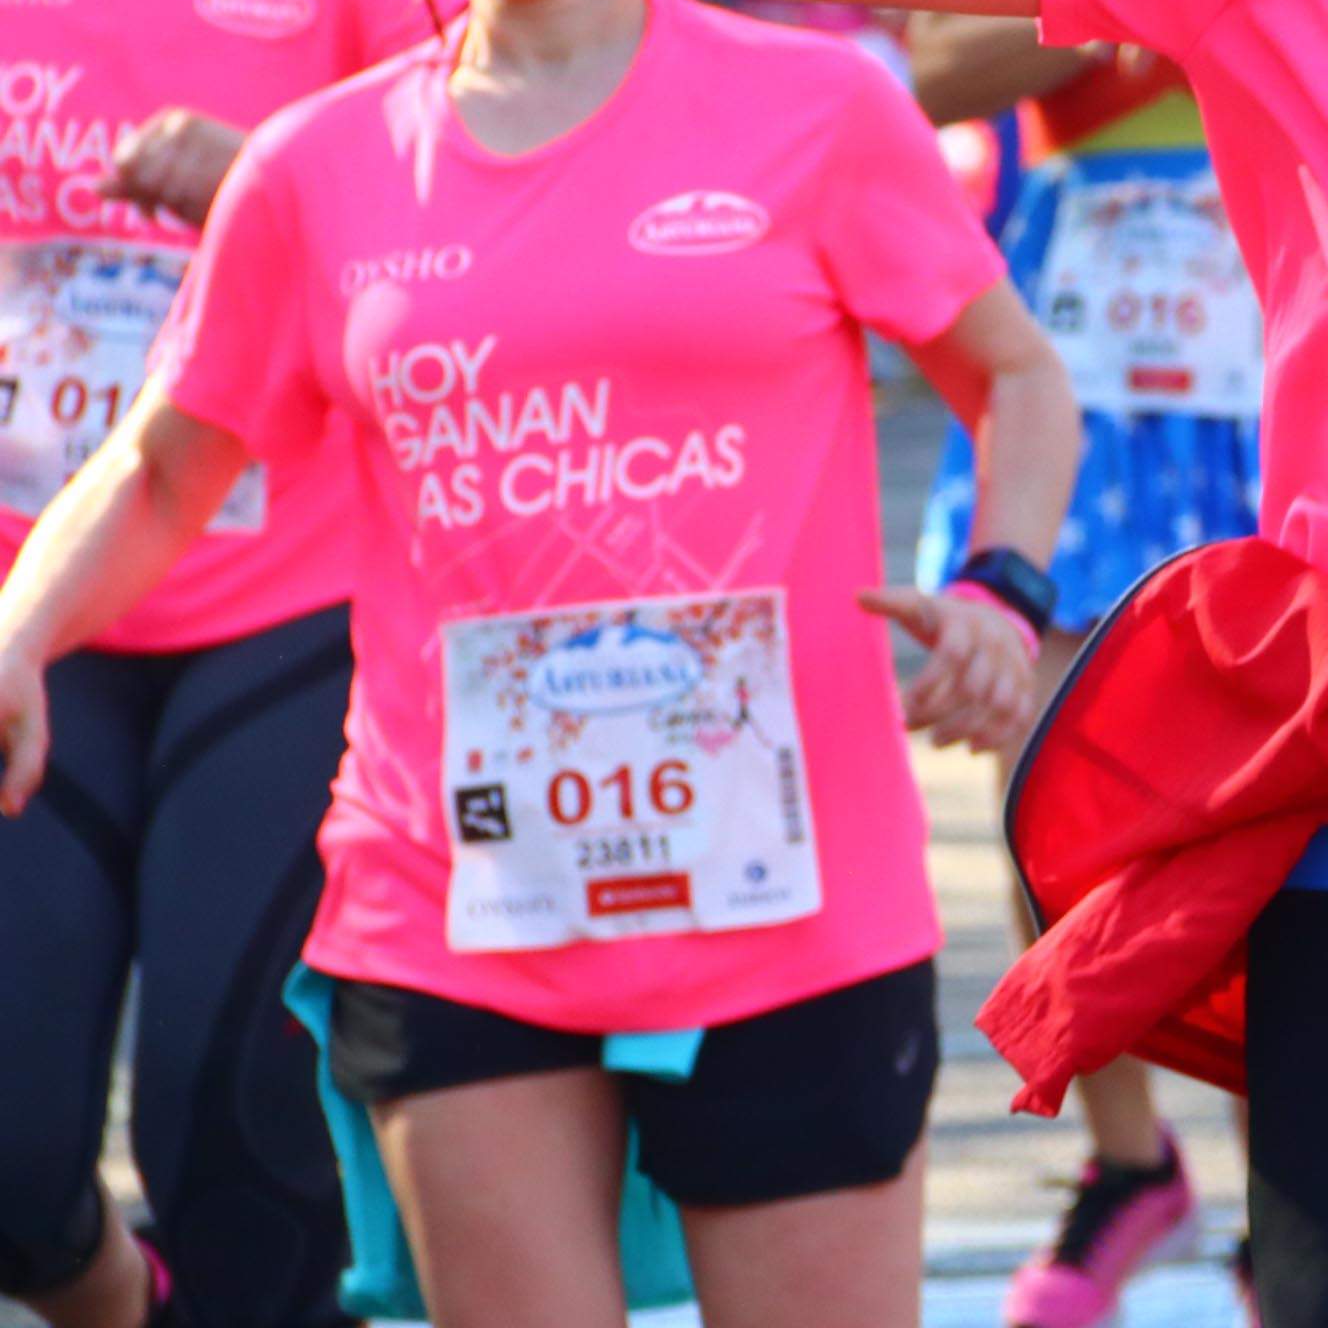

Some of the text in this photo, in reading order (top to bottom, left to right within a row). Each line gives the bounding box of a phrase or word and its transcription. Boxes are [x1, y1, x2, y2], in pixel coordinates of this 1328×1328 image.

[369, 334, 497, 410] HOY
[384, 377, 610, 471] GANAN
[500, 424, 747, 508] CHICAS
[549, 759, 695, 826] 016
